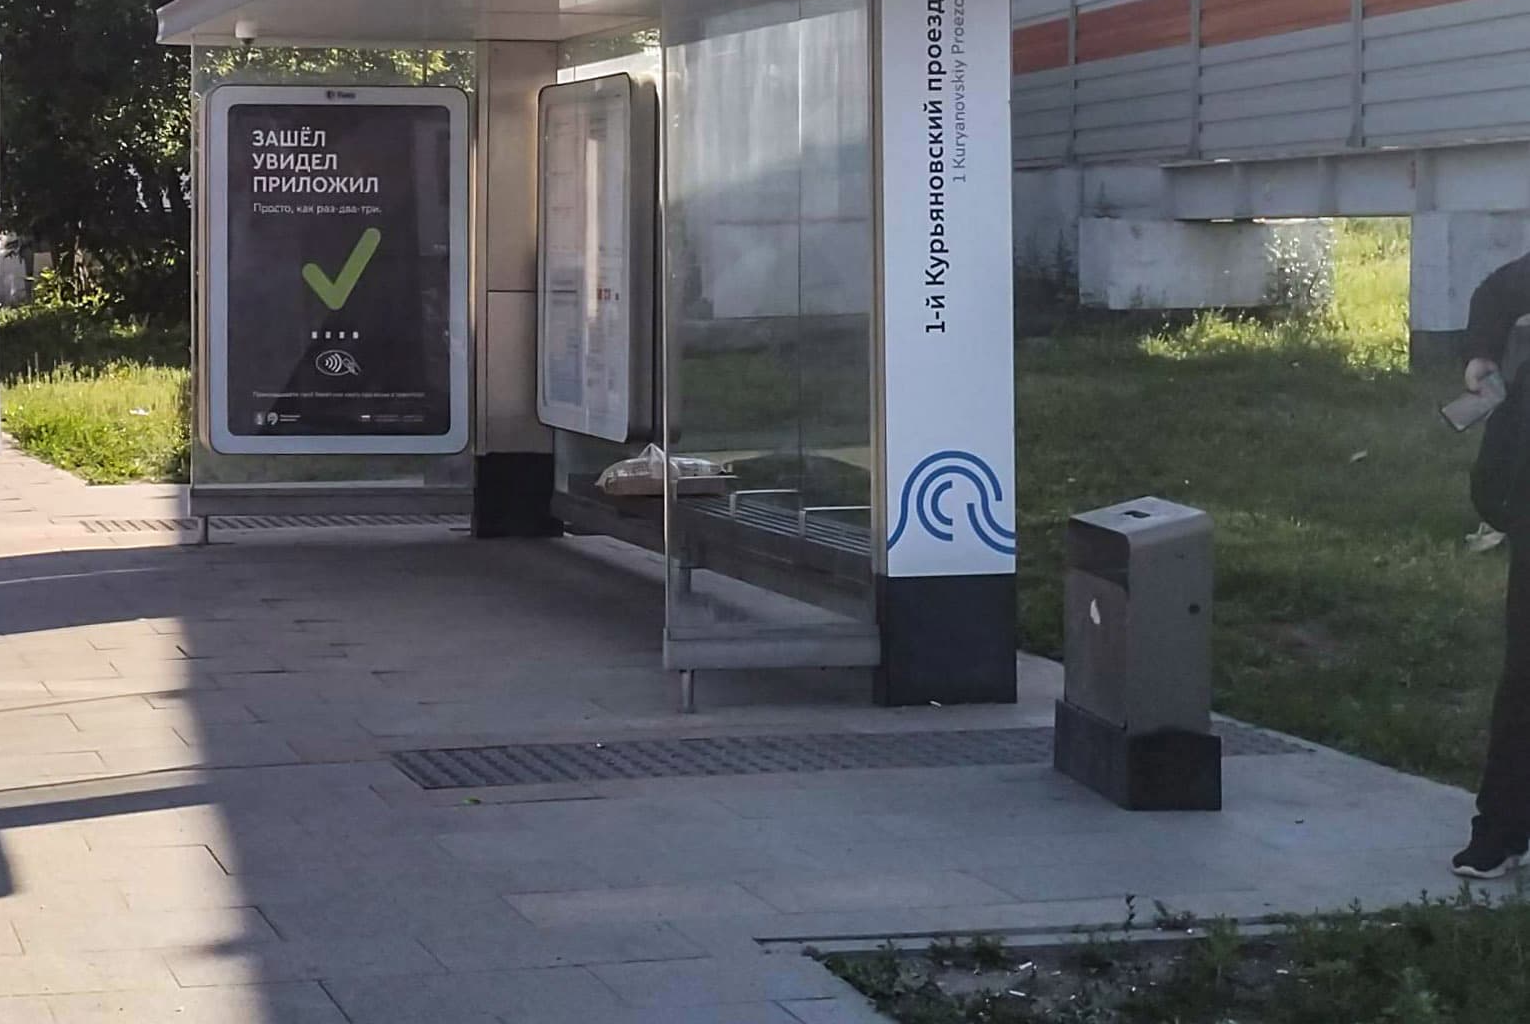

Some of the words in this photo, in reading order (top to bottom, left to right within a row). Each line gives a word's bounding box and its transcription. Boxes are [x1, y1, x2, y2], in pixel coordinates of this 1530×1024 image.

[950, 59, 969, 168] Kuryanovskiy
[252, 126, 326, 147] ЗАШЁЛ
[252, 153, 337, 173] УВИДЕЛ
[253, 176, 379, 193] ПРИЛОЖИЛ
[922, 100, 950, 285] Курьяновский
[926, 295, 945, 333] 1-й
